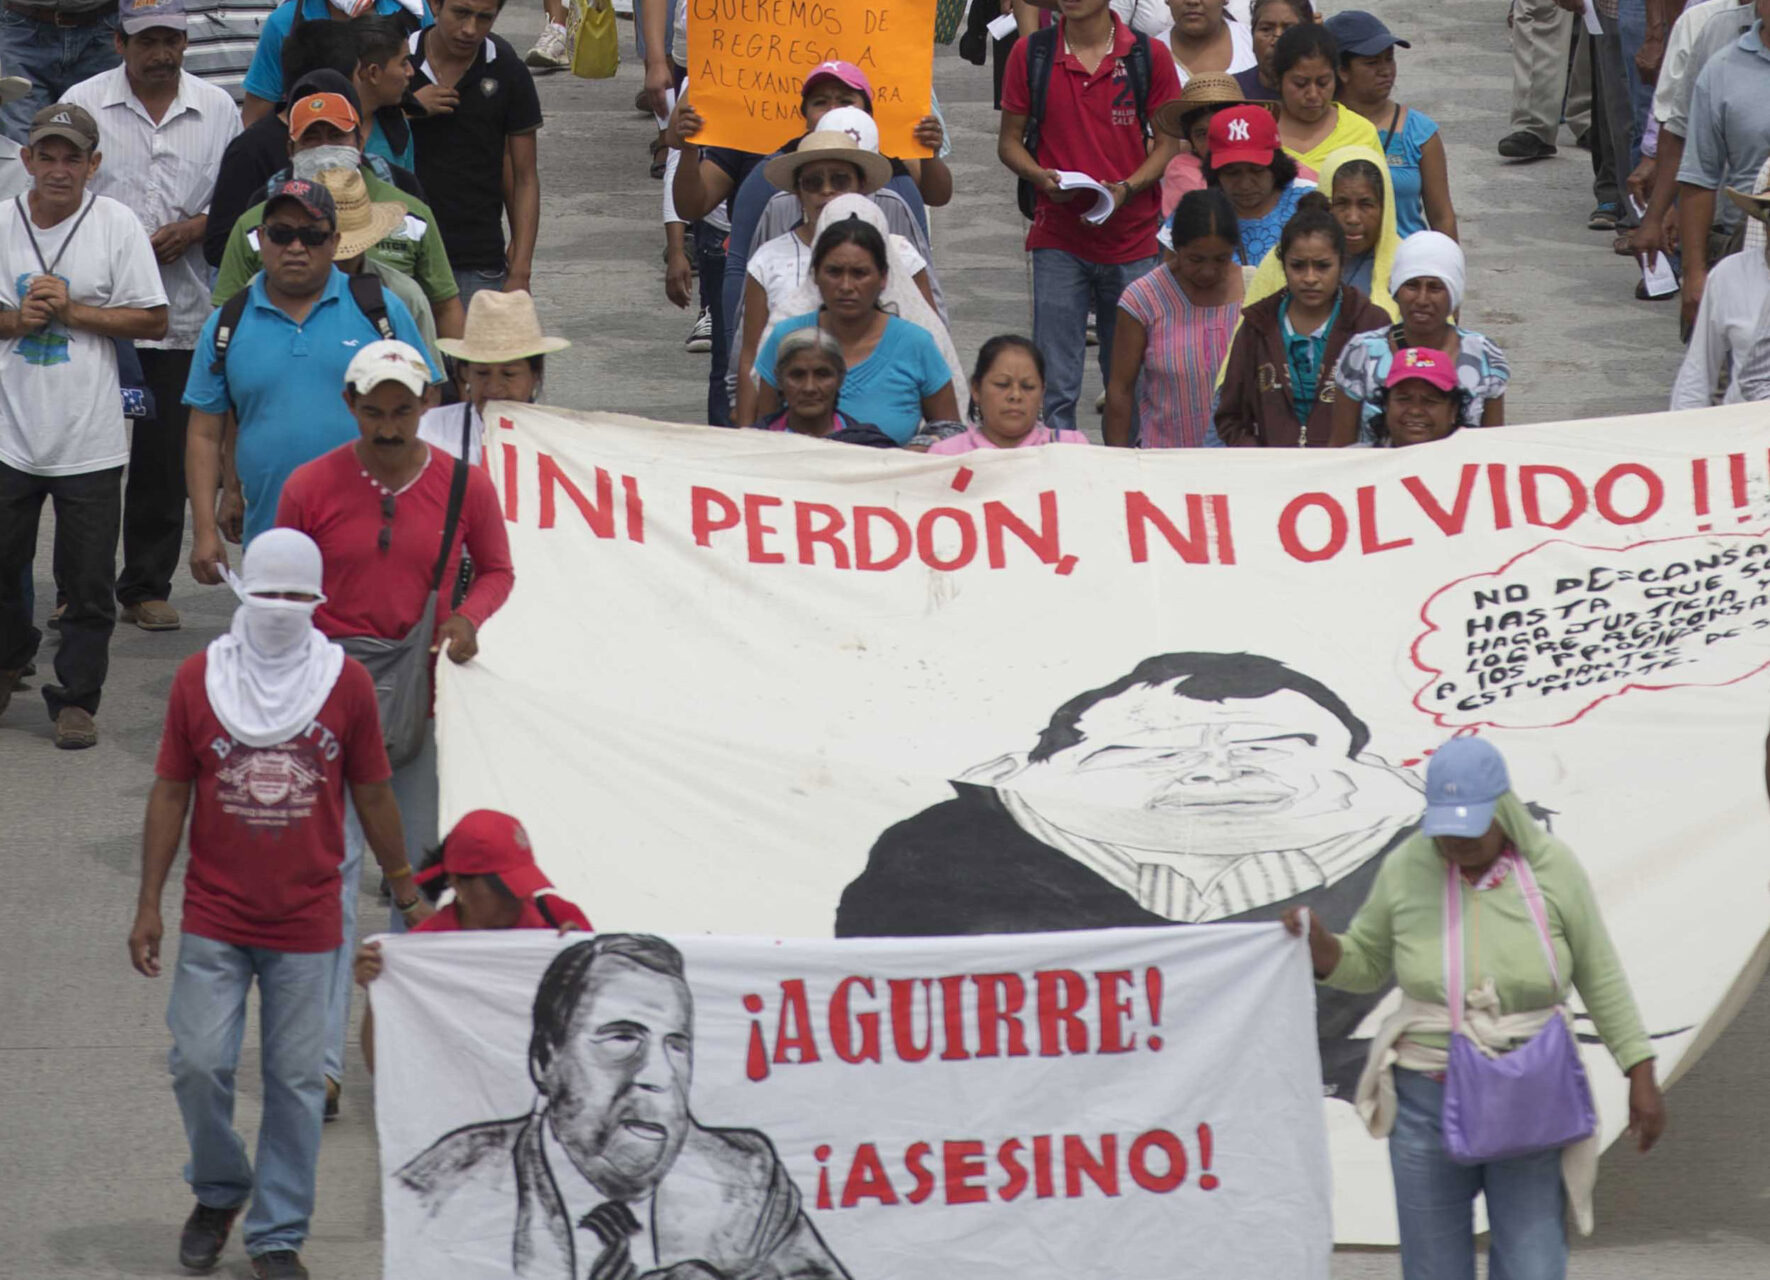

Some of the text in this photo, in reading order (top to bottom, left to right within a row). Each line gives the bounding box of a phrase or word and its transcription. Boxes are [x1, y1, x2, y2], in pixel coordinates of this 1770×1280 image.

[864, 9, 890, 35] DE
[856, 45, 878, 69] A
[1124, 490, 1237, 566] NI
[1466, 597, 1612, 638] HASTA
[1643, 574, 1723, 599] QUE
[1473, 583, 1529, 610] NO
[742, 965, 1163, 1083] ¡AGUIRRE!
[813, 1121, 1221, 1211] ¡ASESINO!
